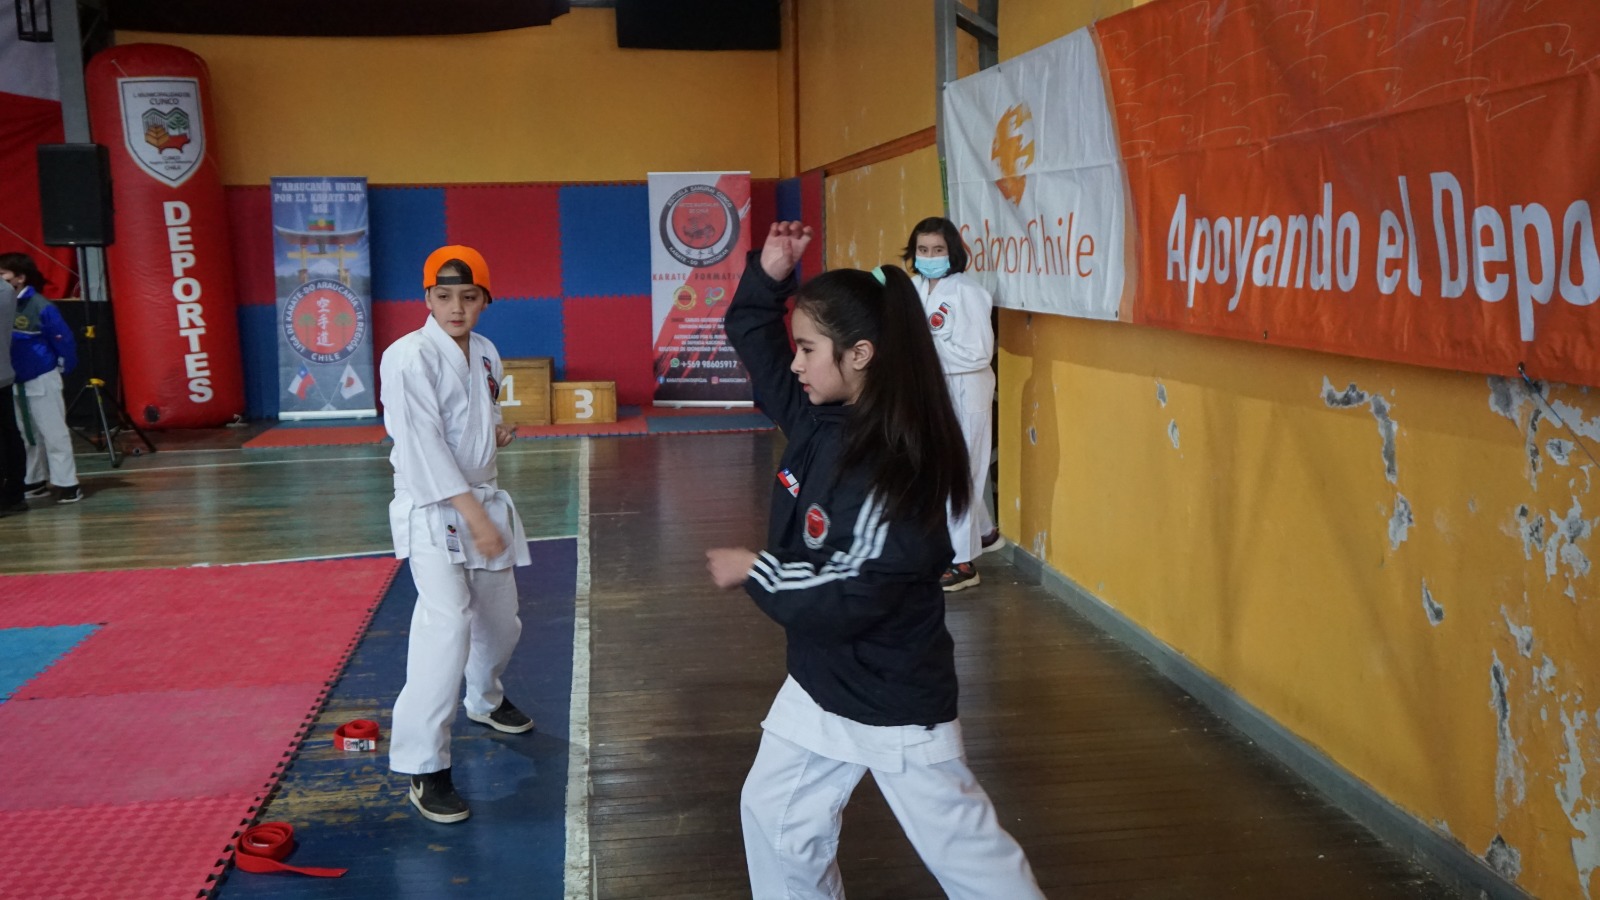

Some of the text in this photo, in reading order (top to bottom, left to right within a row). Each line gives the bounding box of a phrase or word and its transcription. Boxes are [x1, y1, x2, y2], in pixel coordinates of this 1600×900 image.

[335, 182, 362, 191] UNIDA
[274, 193, 293, 202] POR
[295, 193, 307, 202] EL
[310, 193, 345, 202] KARATE
[959, 211, 1095, 278] SalmonChile
[1166, 182, 1360, 311] Apoyando
[1376, 175, 1422, 296] el
[652, 273, 686, 281] KARATE
[163, 200, 214, 404] DEPORTES
[289, 334, 306, 353] LIGA
[311, 352, 341, 362] CHILE
[681, 360, 738, 368] +569 98605917
[500, 374, 522, 407] 1
[574, 388, 594, 419] 3
